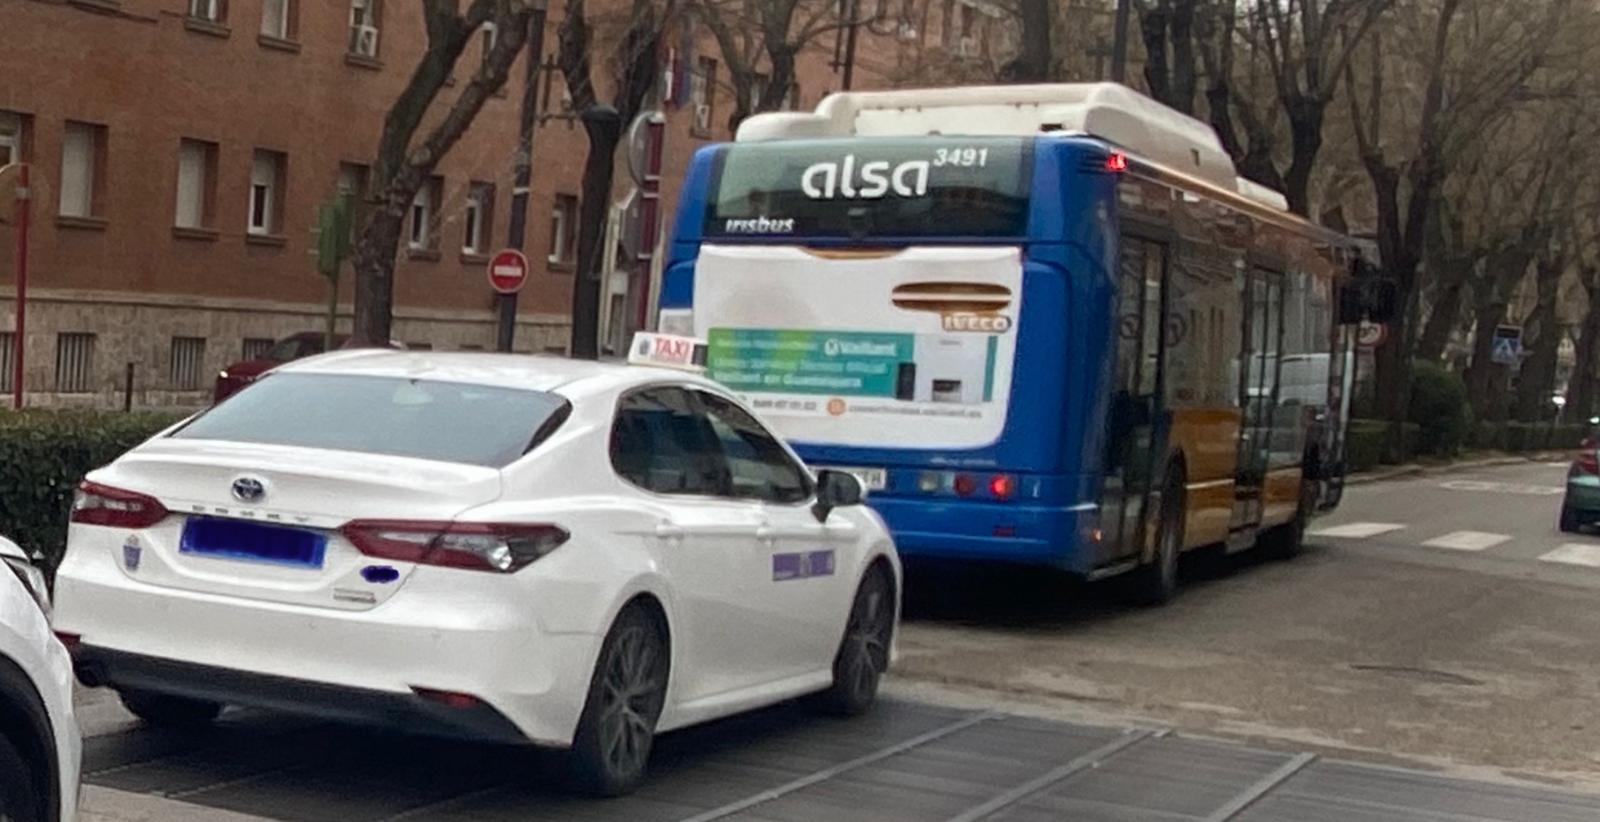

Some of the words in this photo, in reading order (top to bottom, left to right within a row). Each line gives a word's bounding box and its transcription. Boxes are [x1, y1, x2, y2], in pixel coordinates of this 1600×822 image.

[933, 147, 988, 167] 3491
[801, 154, 930, 199] alsa
[944, 315, 1009, 331] IVECO
[654, 336, 691, 356] TAXI
